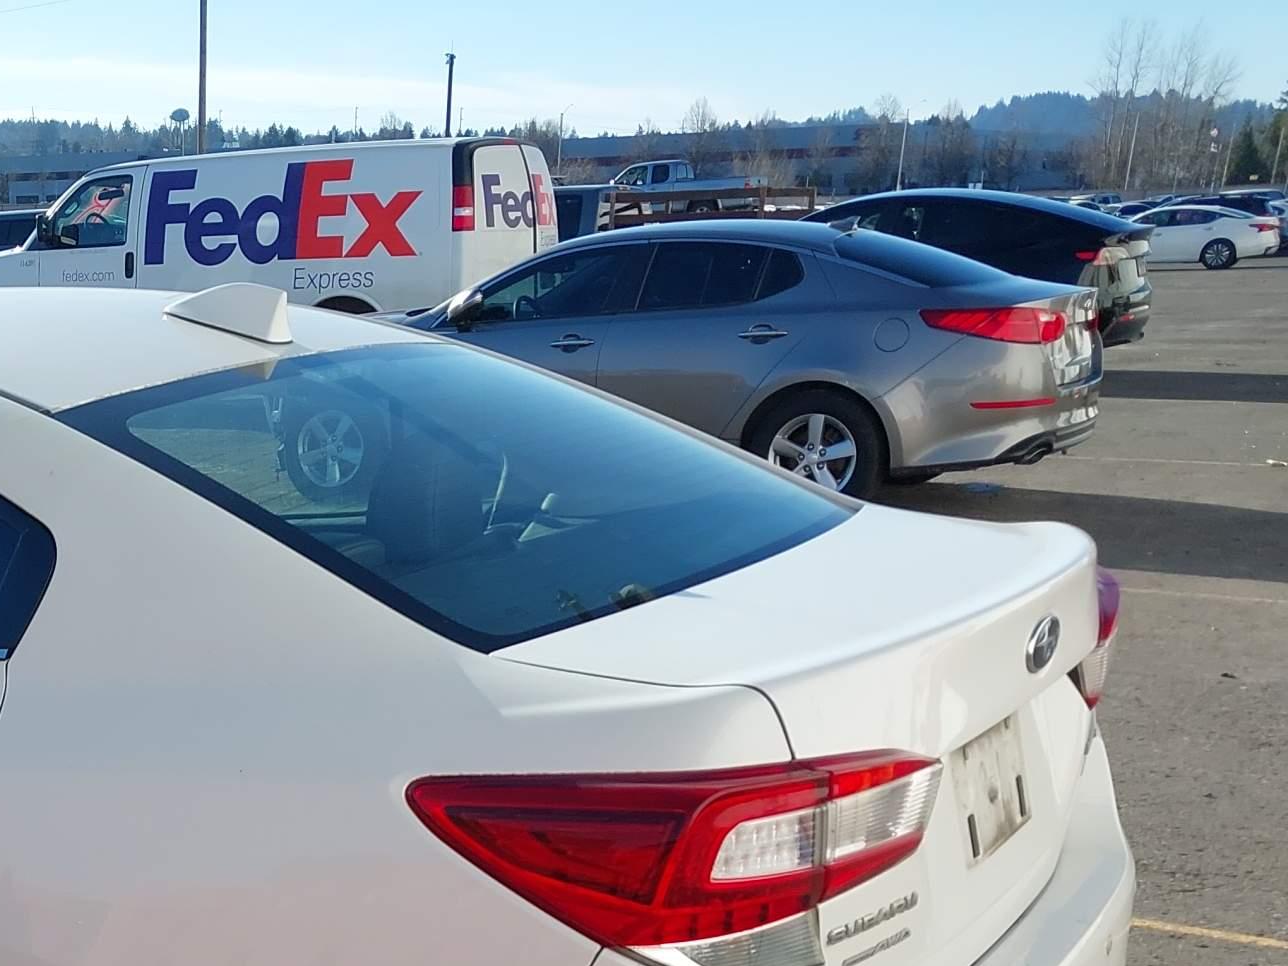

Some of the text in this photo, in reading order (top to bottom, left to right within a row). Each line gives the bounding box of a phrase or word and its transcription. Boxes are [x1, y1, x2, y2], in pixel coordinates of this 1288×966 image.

[144, 159, 423, 266] FedEx
[62, 269, 115, 283] fedex.com
[293, 268, 374, 294] Express
